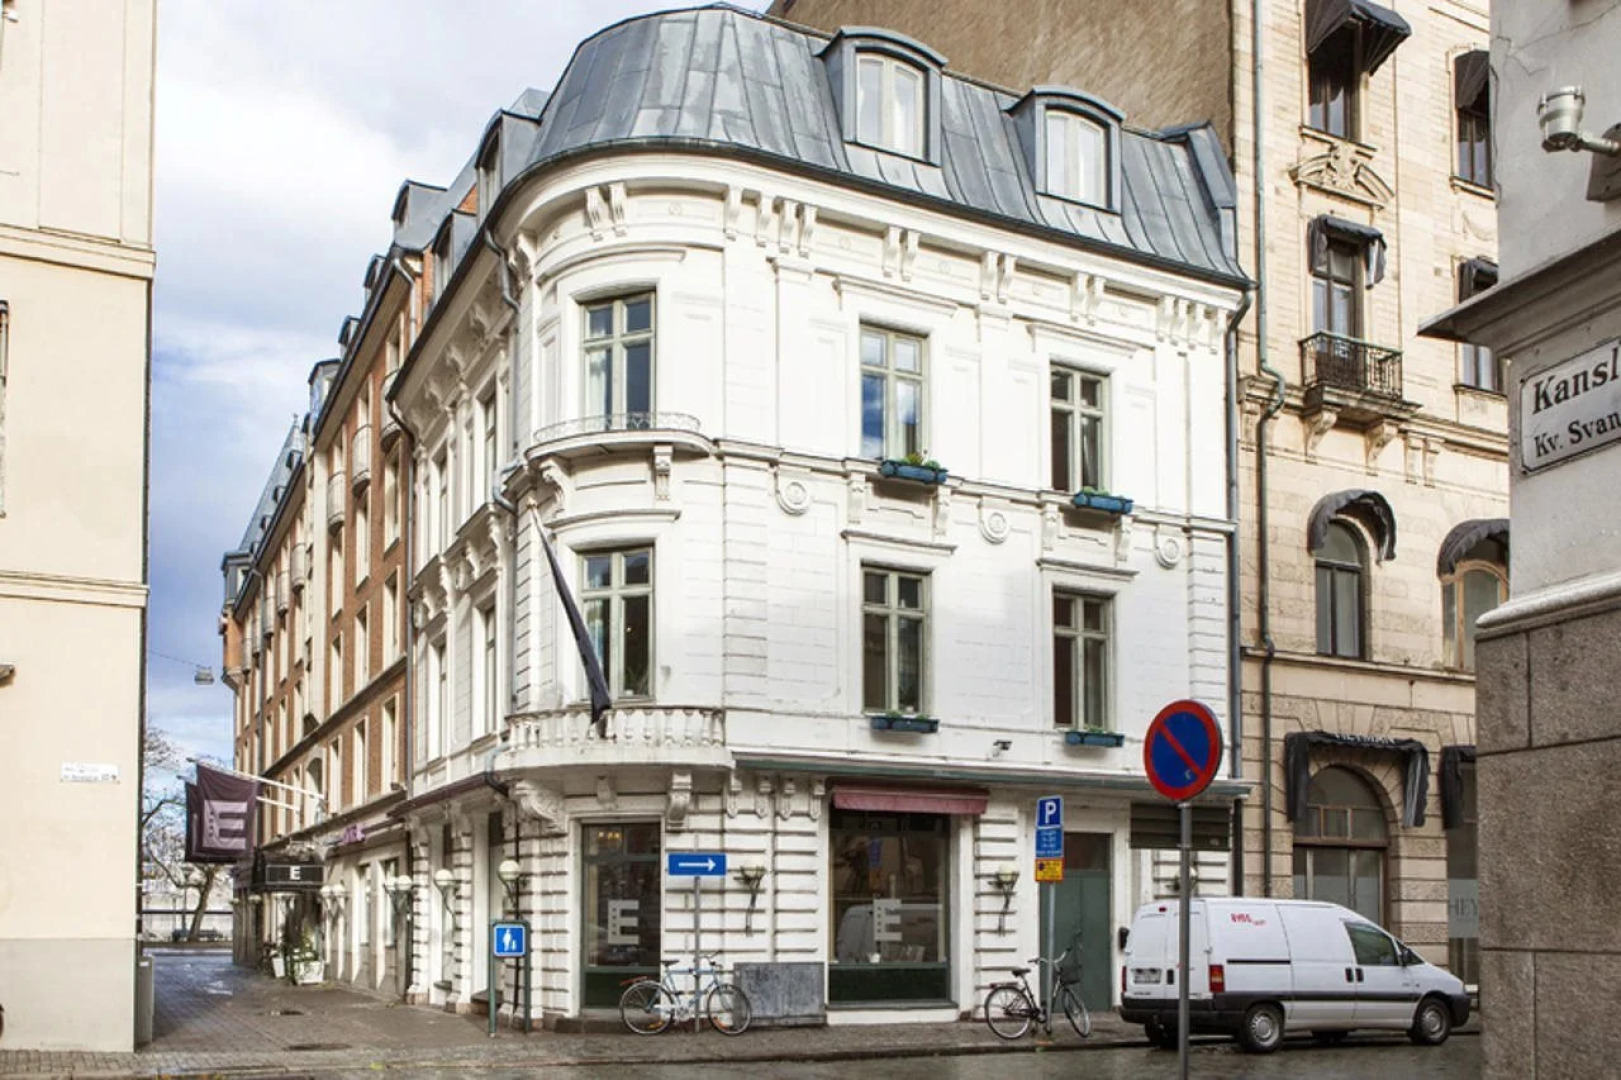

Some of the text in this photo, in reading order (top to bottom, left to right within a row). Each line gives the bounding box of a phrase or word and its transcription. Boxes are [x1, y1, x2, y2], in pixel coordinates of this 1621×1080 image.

[1532, 347, 1619, 414] Kansl
[1534, 411, 1621, 458] Kv. Svan
[1045, 801, 1056, 824] P
